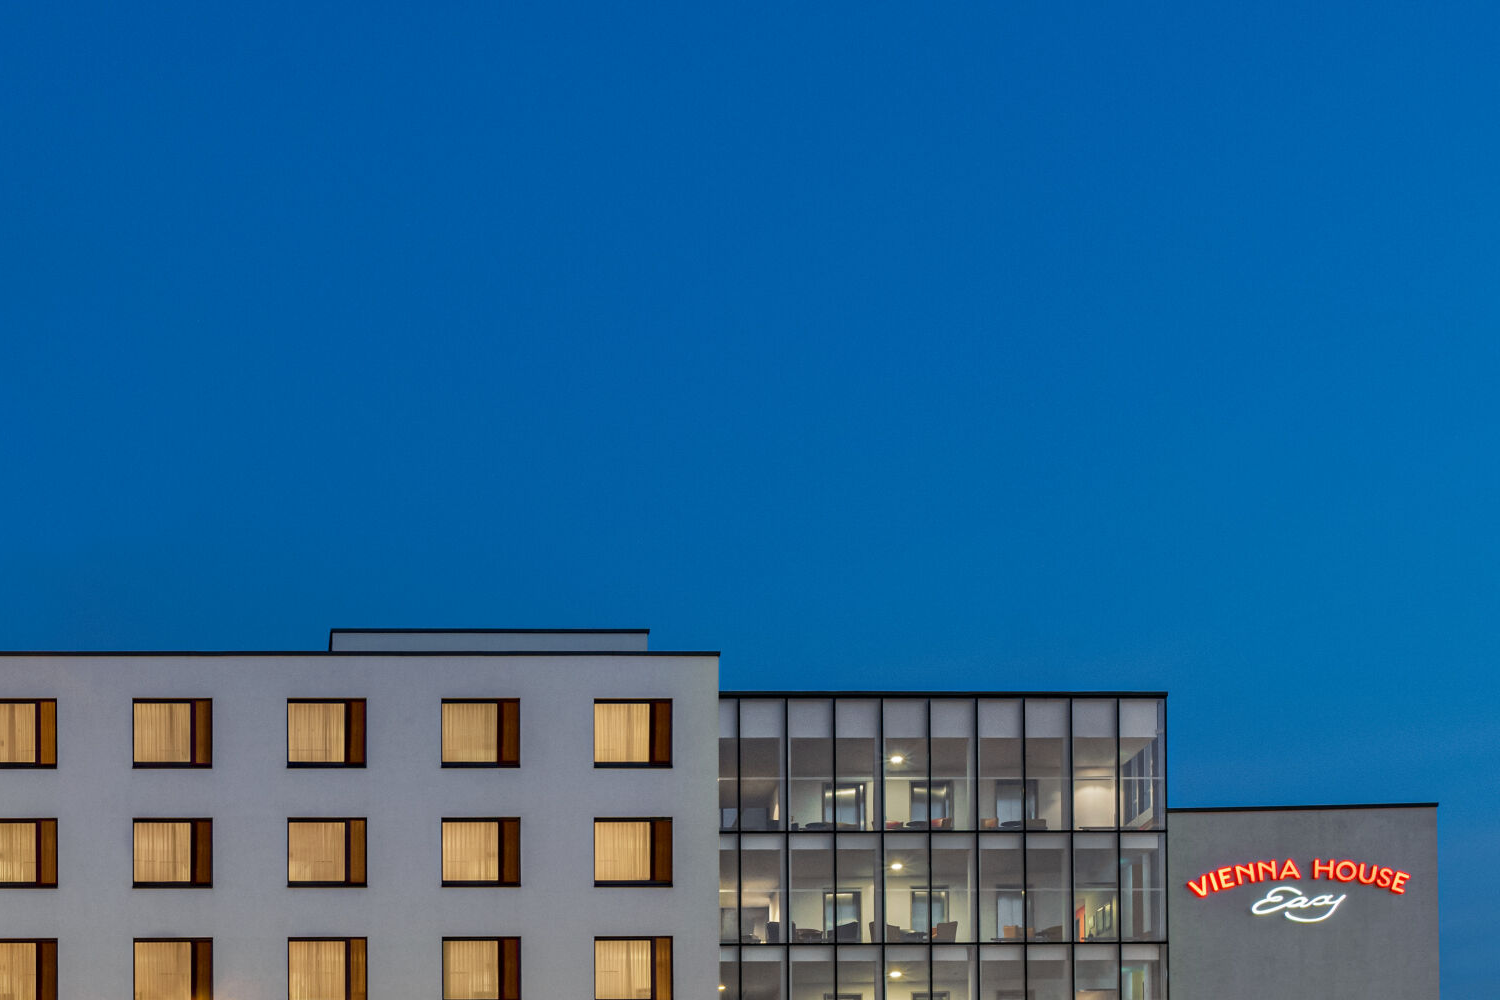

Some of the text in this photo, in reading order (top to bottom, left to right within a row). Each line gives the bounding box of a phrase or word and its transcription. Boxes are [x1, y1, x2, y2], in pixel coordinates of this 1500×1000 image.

[1188, 858, 1411, 898] VIENNA HOUSE
[1251, 886, 1347, 923] Easy
